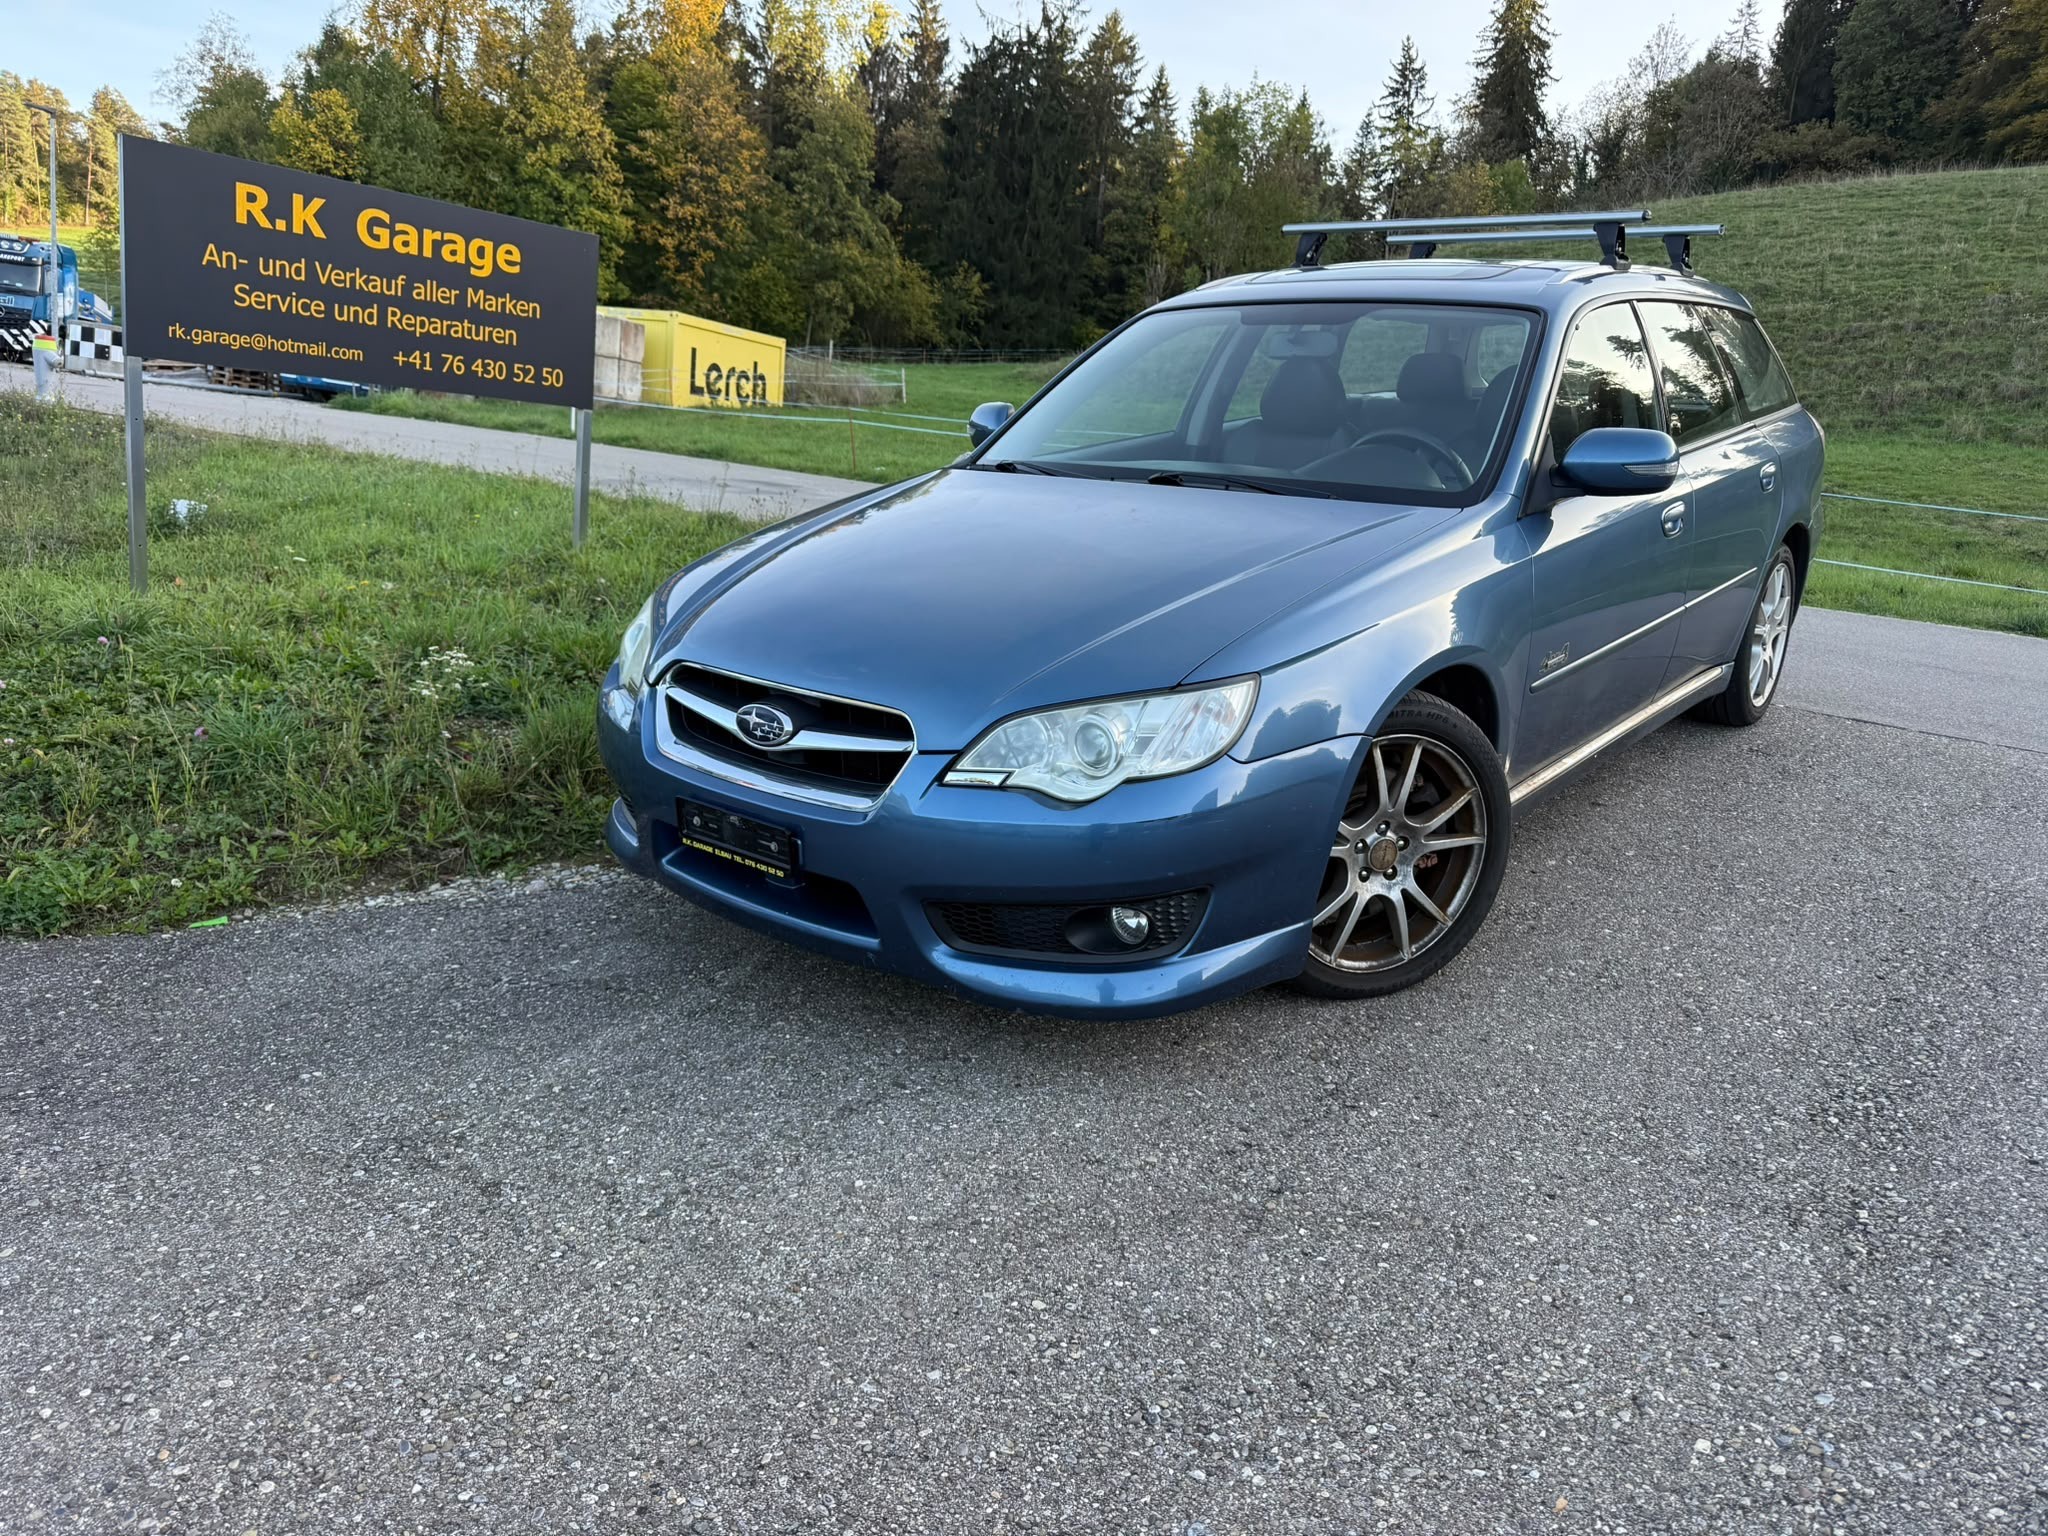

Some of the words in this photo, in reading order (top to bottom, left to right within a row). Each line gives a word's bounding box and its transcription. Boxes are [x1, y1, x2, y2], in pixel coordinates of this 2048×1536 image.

[234, 180, 327, 240] R.K
[355, 207, 522, 278] Garage
[201, 242, 249, 271] An-
[258, 257, 306, 282] und
[314, 261, 406, 297] Verkauf
[412, 279, 460, 306] aller
[466, 287, 541, 319] Marken
[168, 322, 364, 362] rk.garage@hotmail.com
[233, 283, 326, 319] Service
[334, 301, 378, 327] und
[387, 306, 518, 346] Reparaturen
[393, 350, 433, 372] +41
[441, 353, 466, 376] 76
[471, 358, 508, 381] 430
[513, 363, 535, 384] 52
[541, 367, 565, 389] 50
[689, 347, 767, 407] Lerch
[692, 840, 714, 854] GARAGE
